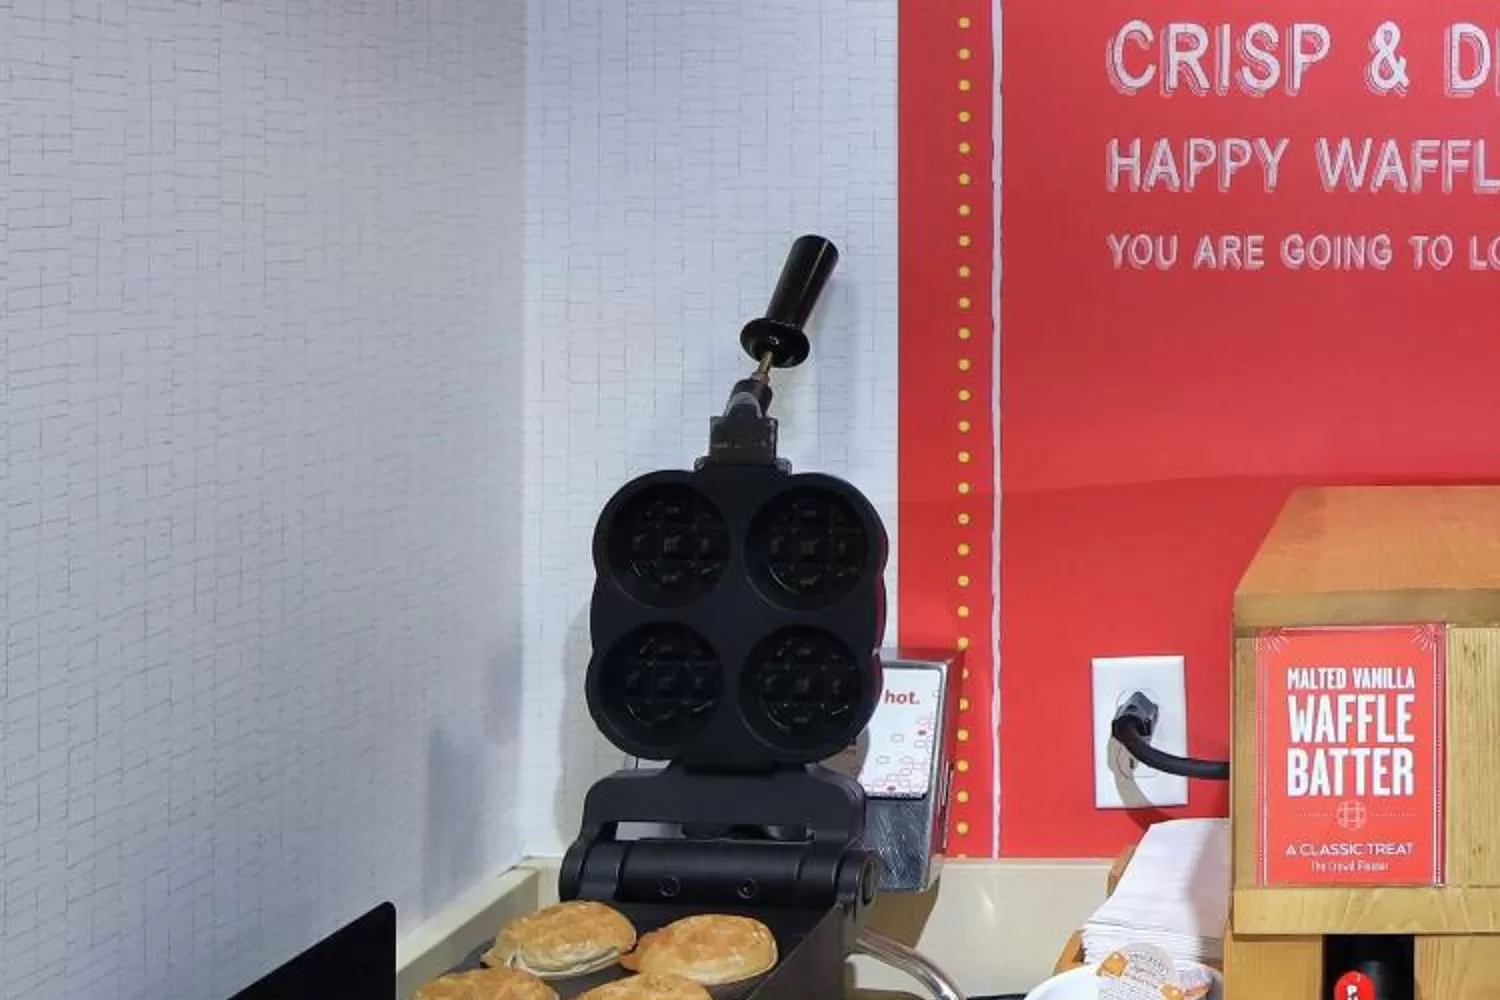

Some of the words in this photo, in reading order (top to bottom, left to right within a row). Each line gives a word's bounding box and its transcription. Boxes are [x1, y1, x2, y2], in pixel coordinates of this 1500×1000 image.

[1106, 20, 1331, 97] CRISP
[1366, 20, 1411, 97] &
[1105, 137, 1290, 193] HAPPY
[1105, 234, 1179, 270] YOU
[1194, 234, 1264, 270] ARE
[1281, 234, 1393, 270] GOING
[1409, 234, 1454, 270] TO
[1286, 666, 1347, 691] MALTED
[1351, 666, 1416, 690] VANILLA
[1287, 694, 1415, 744] WAFFLE
[1285, 748, 1415, 798] BATTER
[1285, 843, 1297, 856] A
[1300, 842, 1363, 857] CLASSIC
[1367, 842, 1413, 856] TREAT
